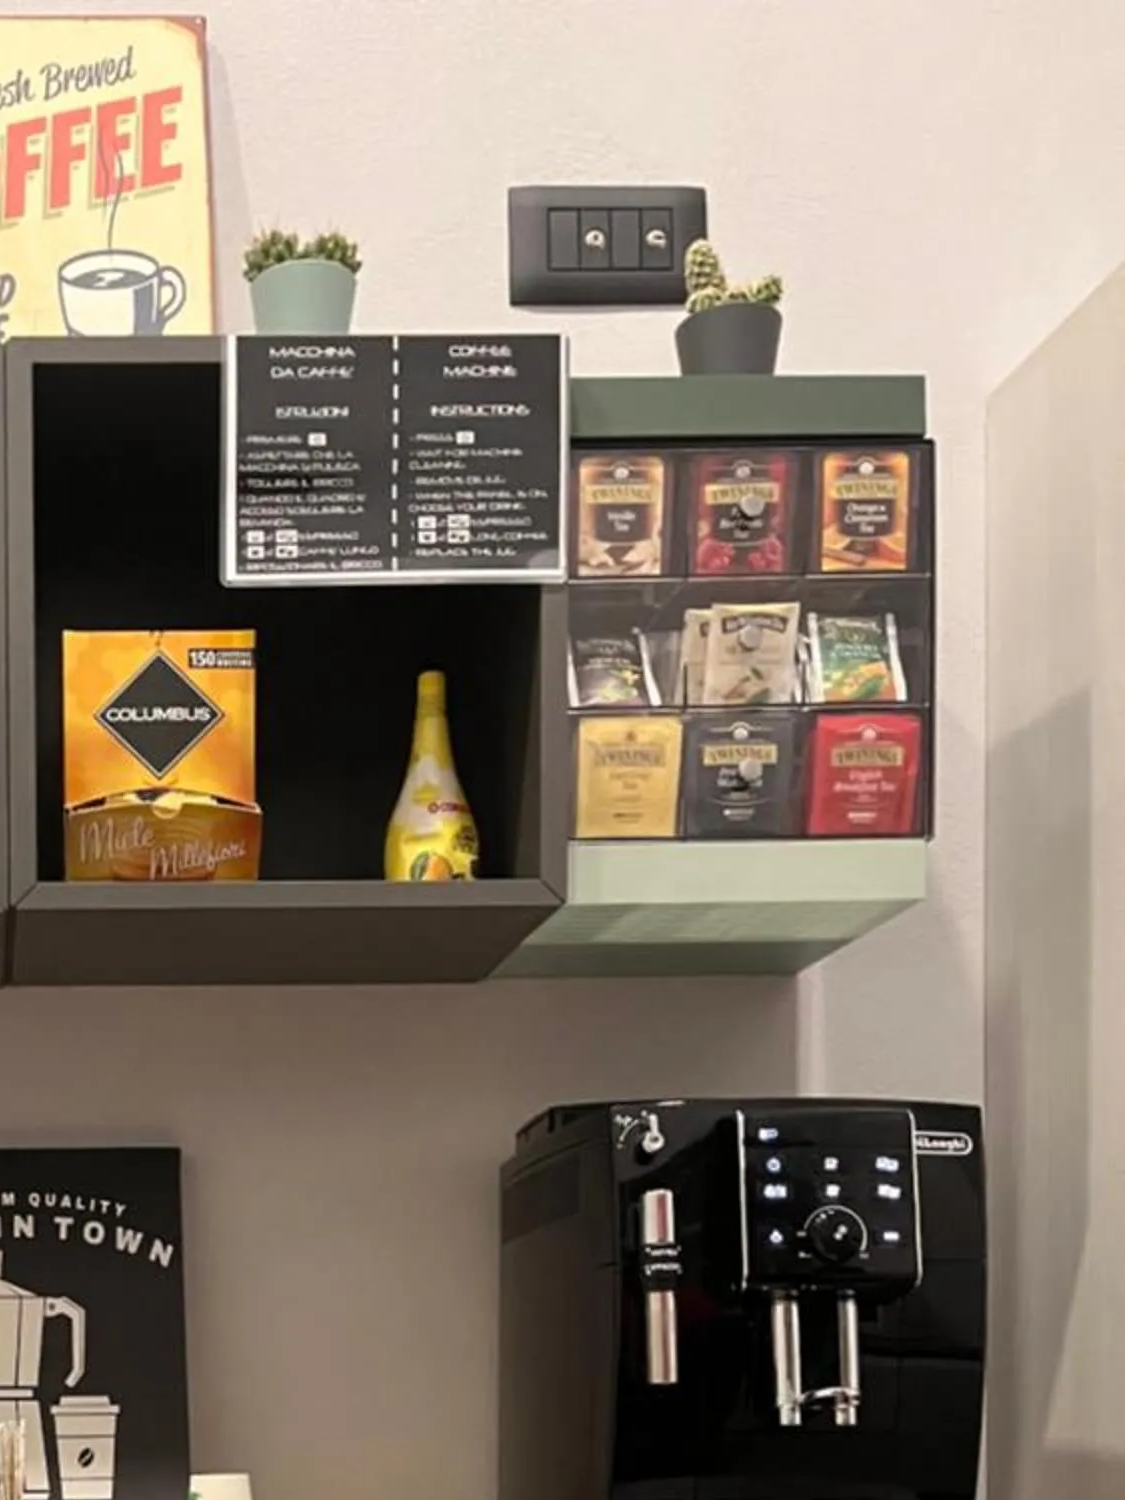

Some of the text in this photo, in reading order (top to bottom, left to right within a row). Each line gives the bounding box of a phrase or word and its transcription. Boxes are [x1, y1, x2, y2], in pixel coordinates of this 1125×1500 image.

[40, 45, 136, 101] Brewed
[270, 366, 294, 379] DA
[190, 651, 216, 667] 150
[106, 706, 211, 722] COLUMBUS
[28, 1192, 127, 1217] QUALITY
[54, 1216, 174, 1268] TOWN
